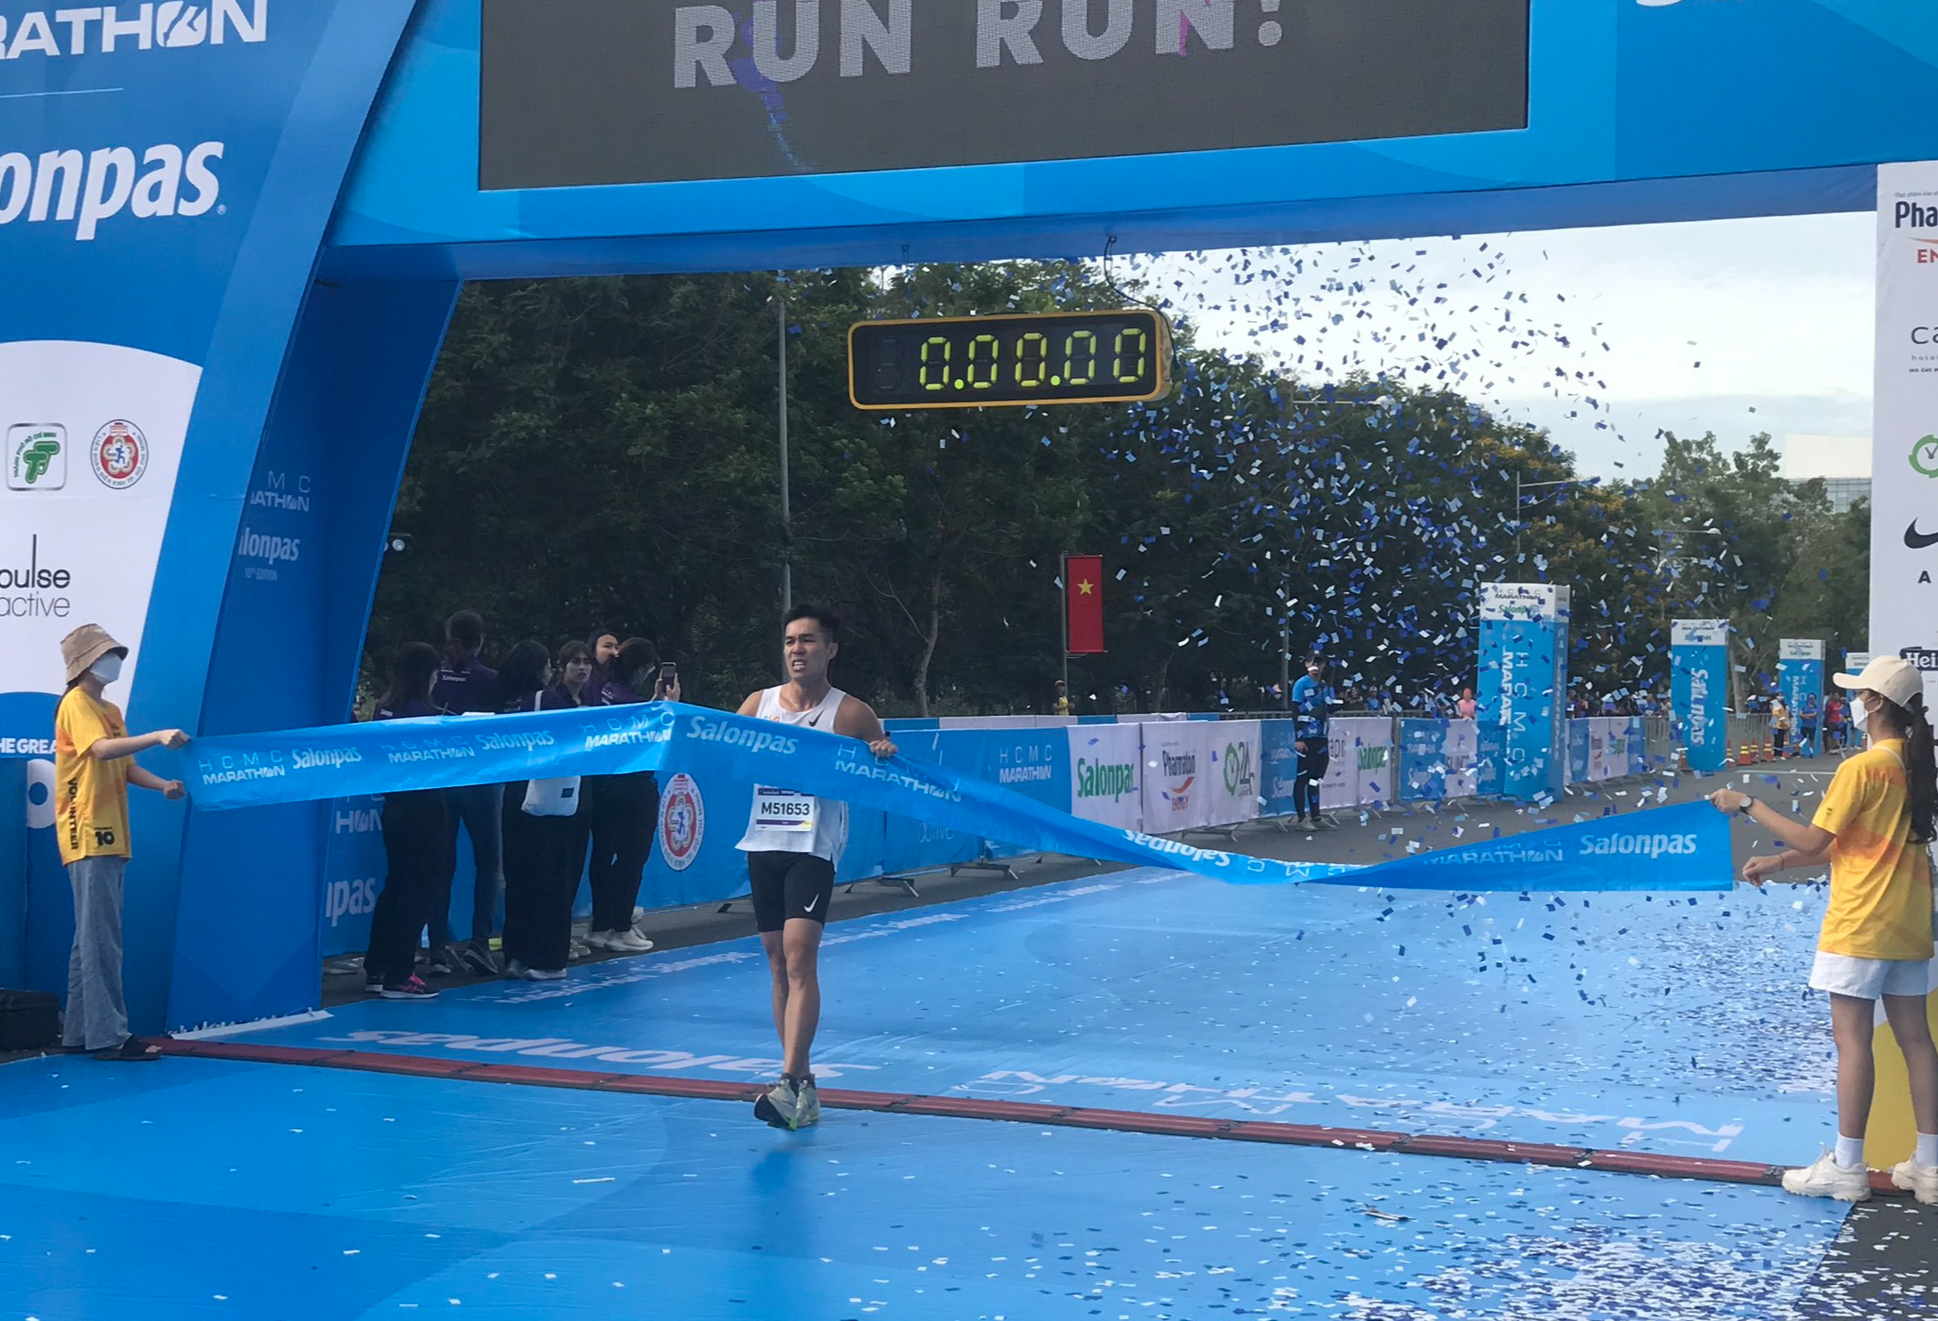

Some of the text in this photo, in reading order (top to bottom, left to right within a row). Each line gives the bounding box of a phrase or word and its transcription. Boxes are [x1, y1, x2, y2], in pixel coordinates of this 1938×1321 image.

[674, 0, 1283, 88] RUN RUN!
[476, 730, 555, 752] Salonpas
[686, 716, 799, 755] Salonpas
[291, 746, 363, 770] Salonpas
[387, 747, 475, 764] MARATHON
[203, 764, 286, 785] MARATHON
[835, 760, 961, 802] MARATHON
[761, 802, 810, 815] M51653
[1579, 833, 1697, 858] Salonpas
